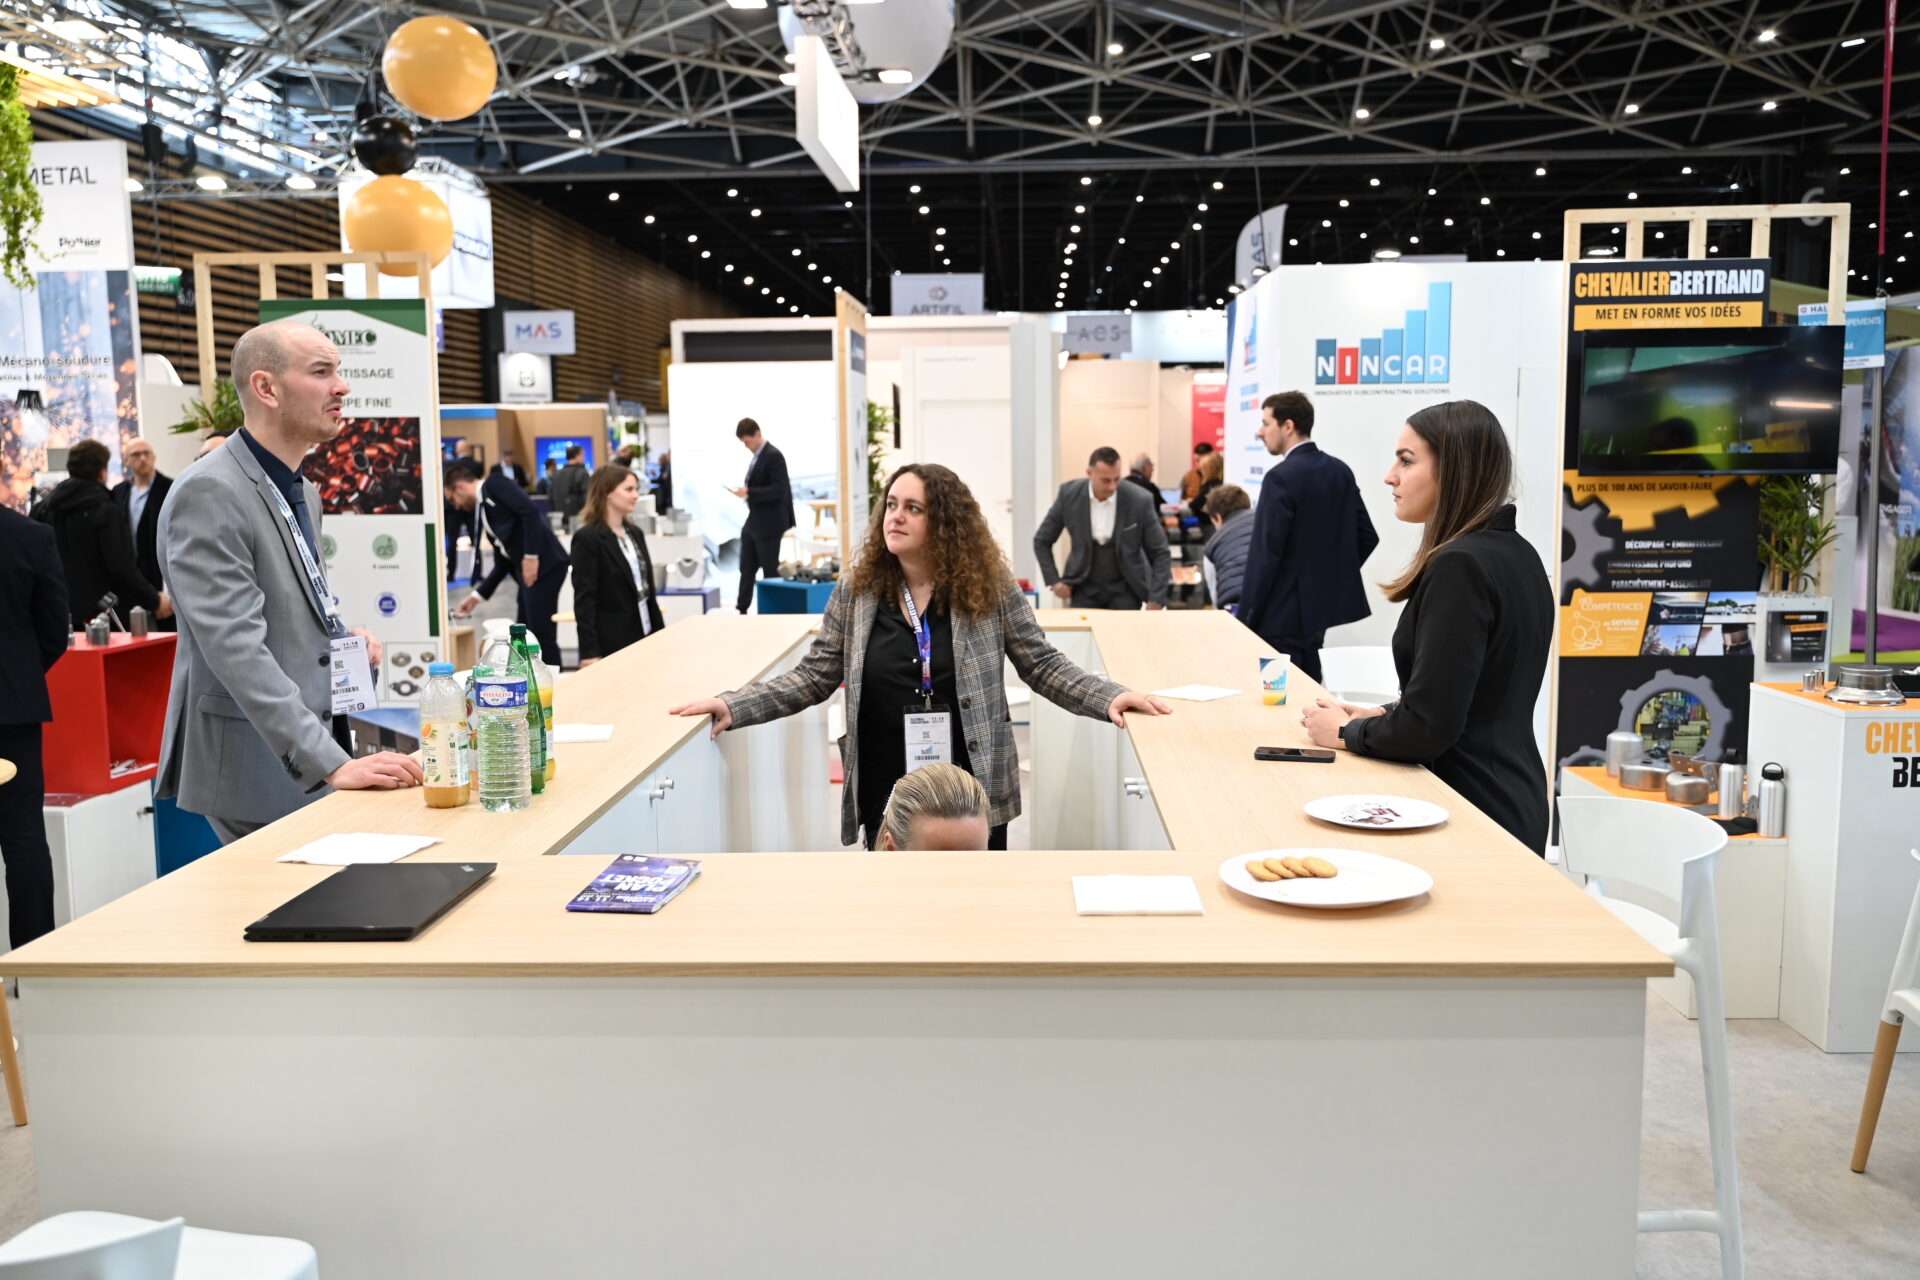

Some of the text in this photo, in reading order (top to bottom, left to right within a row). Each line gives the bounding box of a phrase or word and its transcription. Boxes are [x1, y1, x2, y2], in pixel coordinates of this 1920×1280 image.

[1595, 302, 1741, 320] MET EN FORME VOS IDÉES
[515, 322, 562, 339] MAS
[1317, 355, 1447, 377] NINCAR
[339, 368, 394, 379] TISSAGE
[365, 398, 392, 408] FINE
[1577, 483, 1597, 492] PLUS
[1598, 483, 1609, 491] DE
[1612, 483, 1625, 491] 100
[1628, 482, 1644, 491] ANS
[1646, 482, 1655, 491] DE
